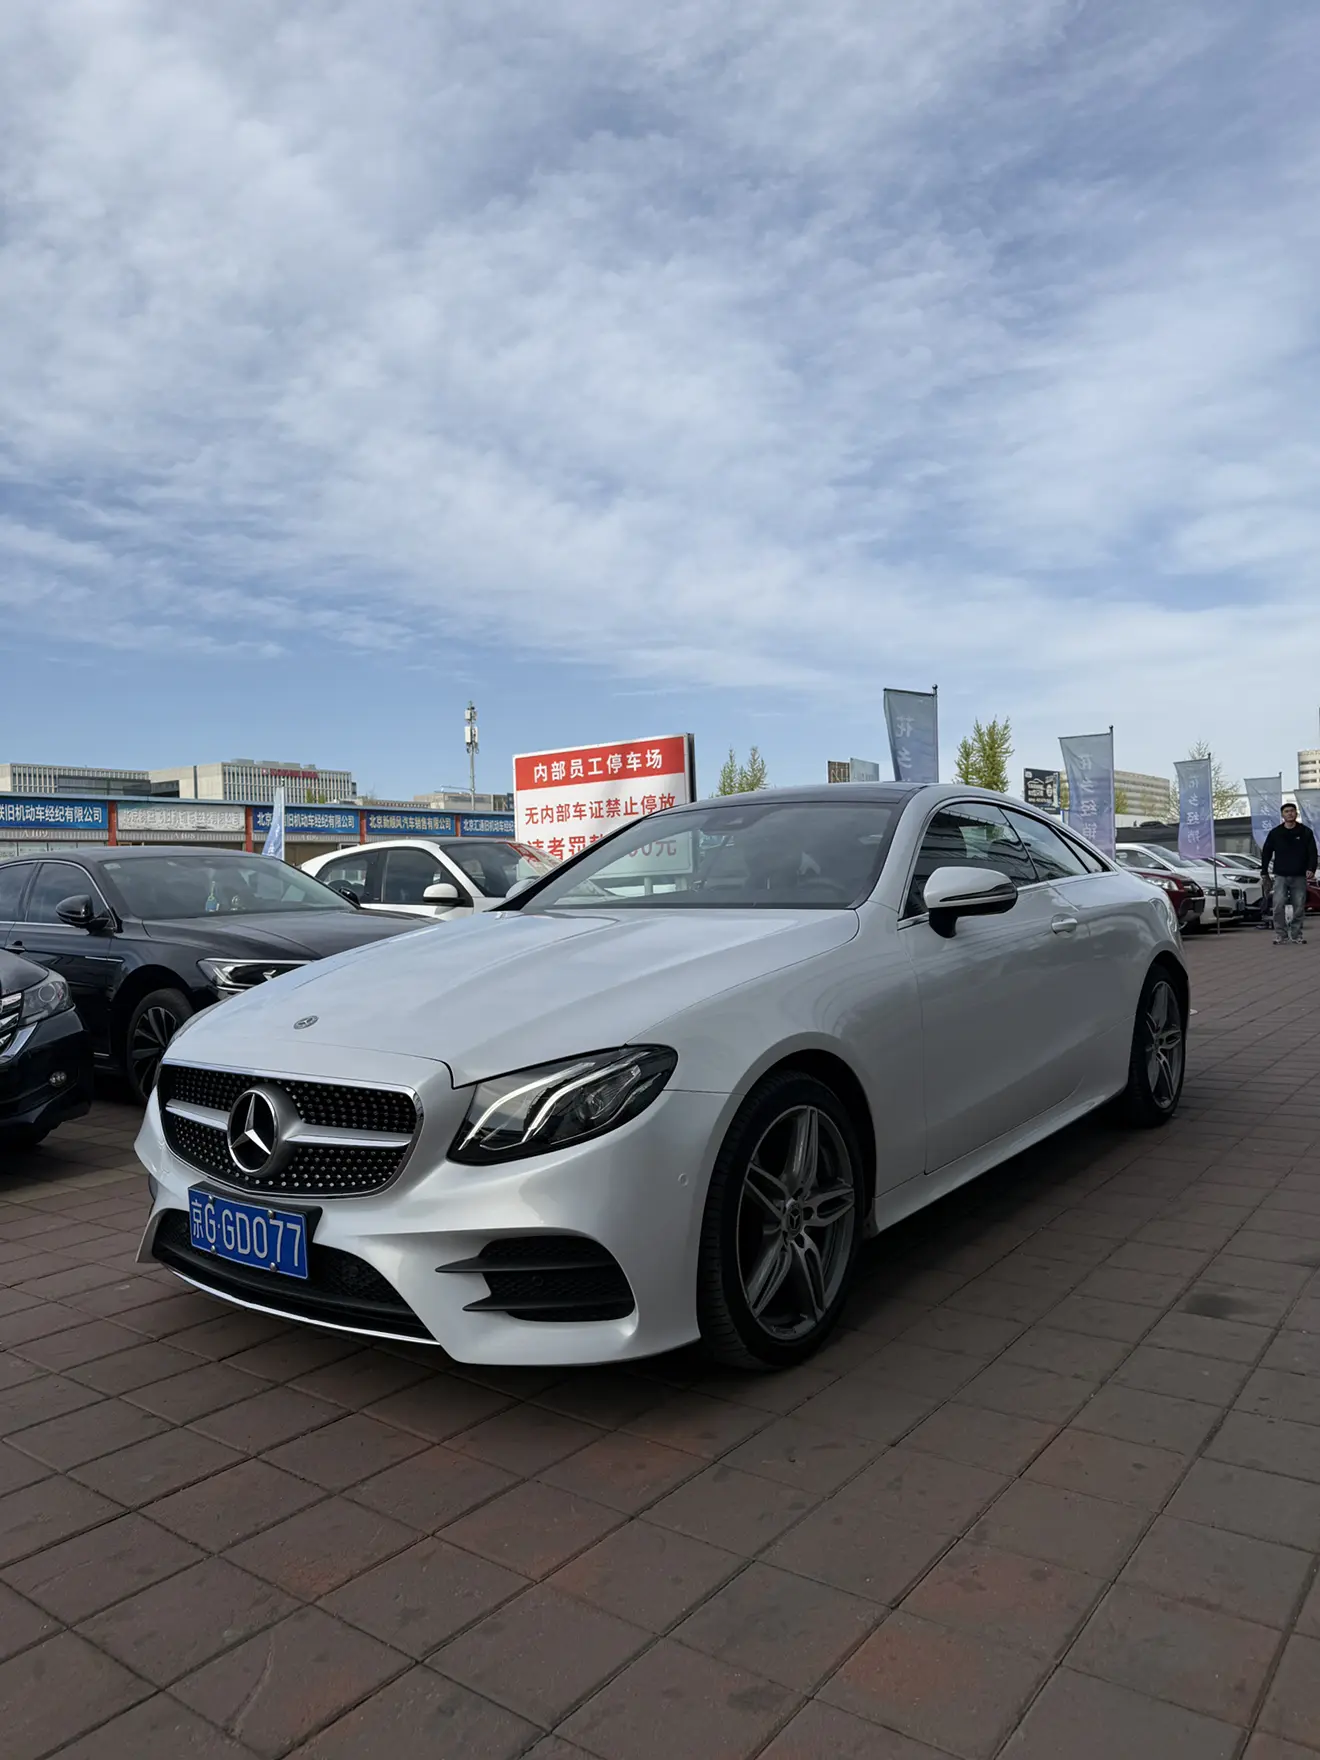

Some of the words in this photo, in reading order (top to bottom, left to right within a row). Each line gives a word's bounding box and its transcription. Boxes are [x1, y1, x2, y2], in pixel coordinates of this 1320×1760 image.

[533, 749, 663, 783] 内部员工停车场
[257, 812, 355, 829] 北京旧机动车经纪有限公司
[525, 793, 676, 825] 无内部车证禁止停放
